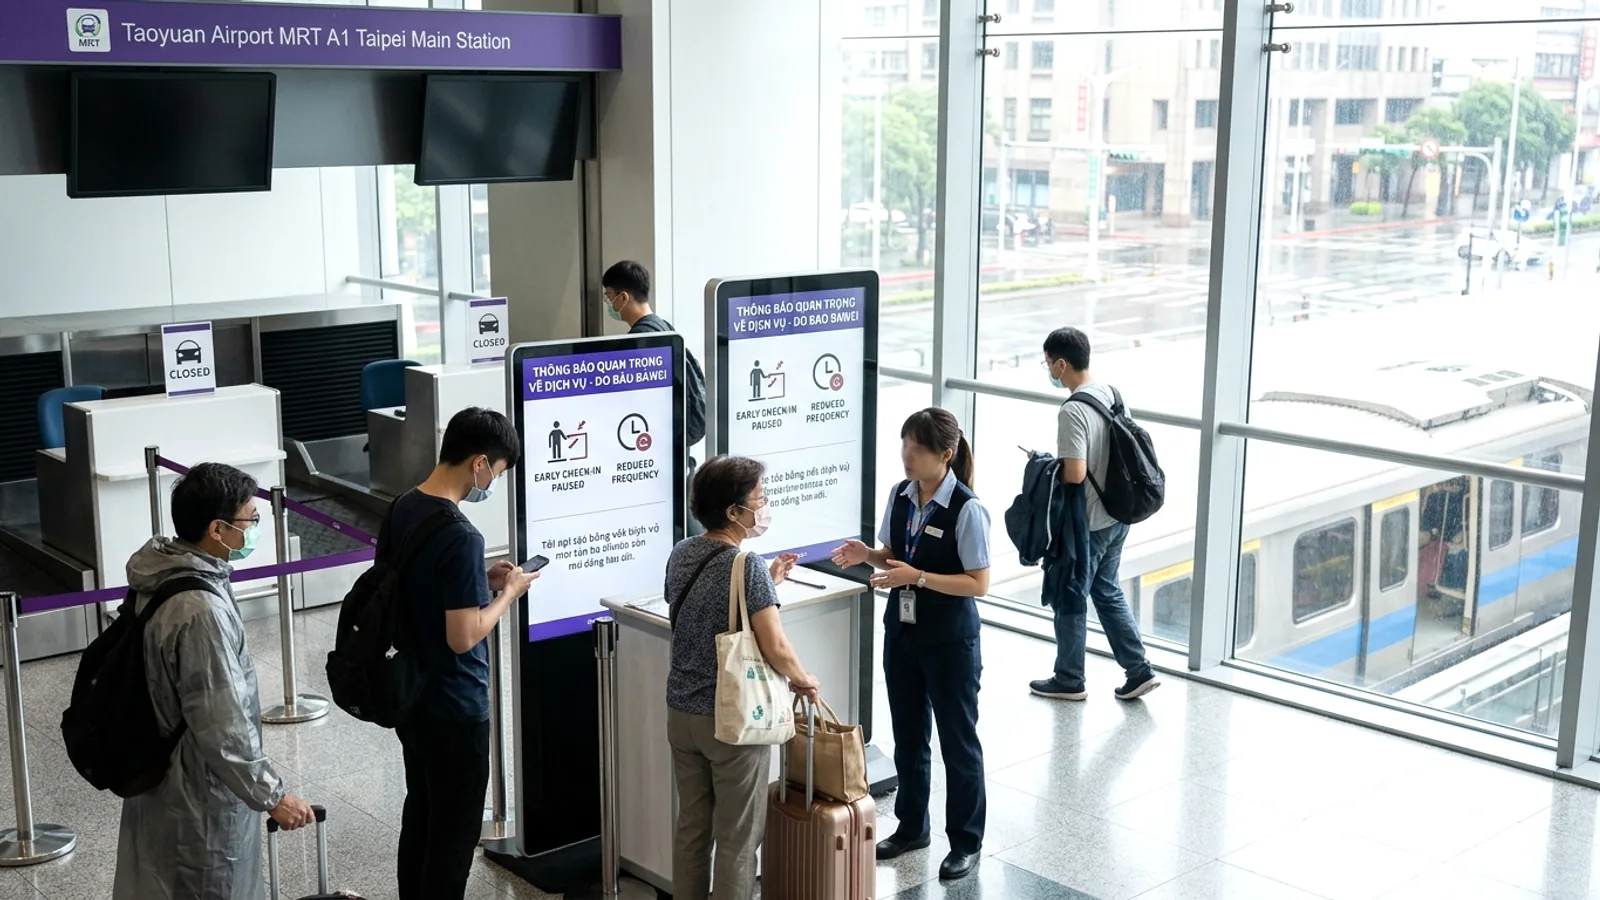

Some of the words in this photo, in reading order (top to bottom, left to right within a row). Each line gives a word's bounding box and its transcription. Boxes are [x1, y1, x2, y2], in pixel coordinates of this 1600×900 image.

[121, 22, 206, 47] Taoyuan
[211, 24, 274, 49] Airport
[279, 26, 321, 46] MRT
[327, 28, 349, 47] A1
[355, 28, 406, 51] Taipei
[411, 30, 451, 48] Main
[455, 31, 511, 50] Station
[78, 39, 100, 47] MRT
[169, 367, 210, 379] CLOSED
[736, 409, 760, 420] EARLY
[534, 471, 560, 482] EARLY
[612, 469, 659, 484] FREQUENCY
[552, 480, 585, 492] PAUSED
